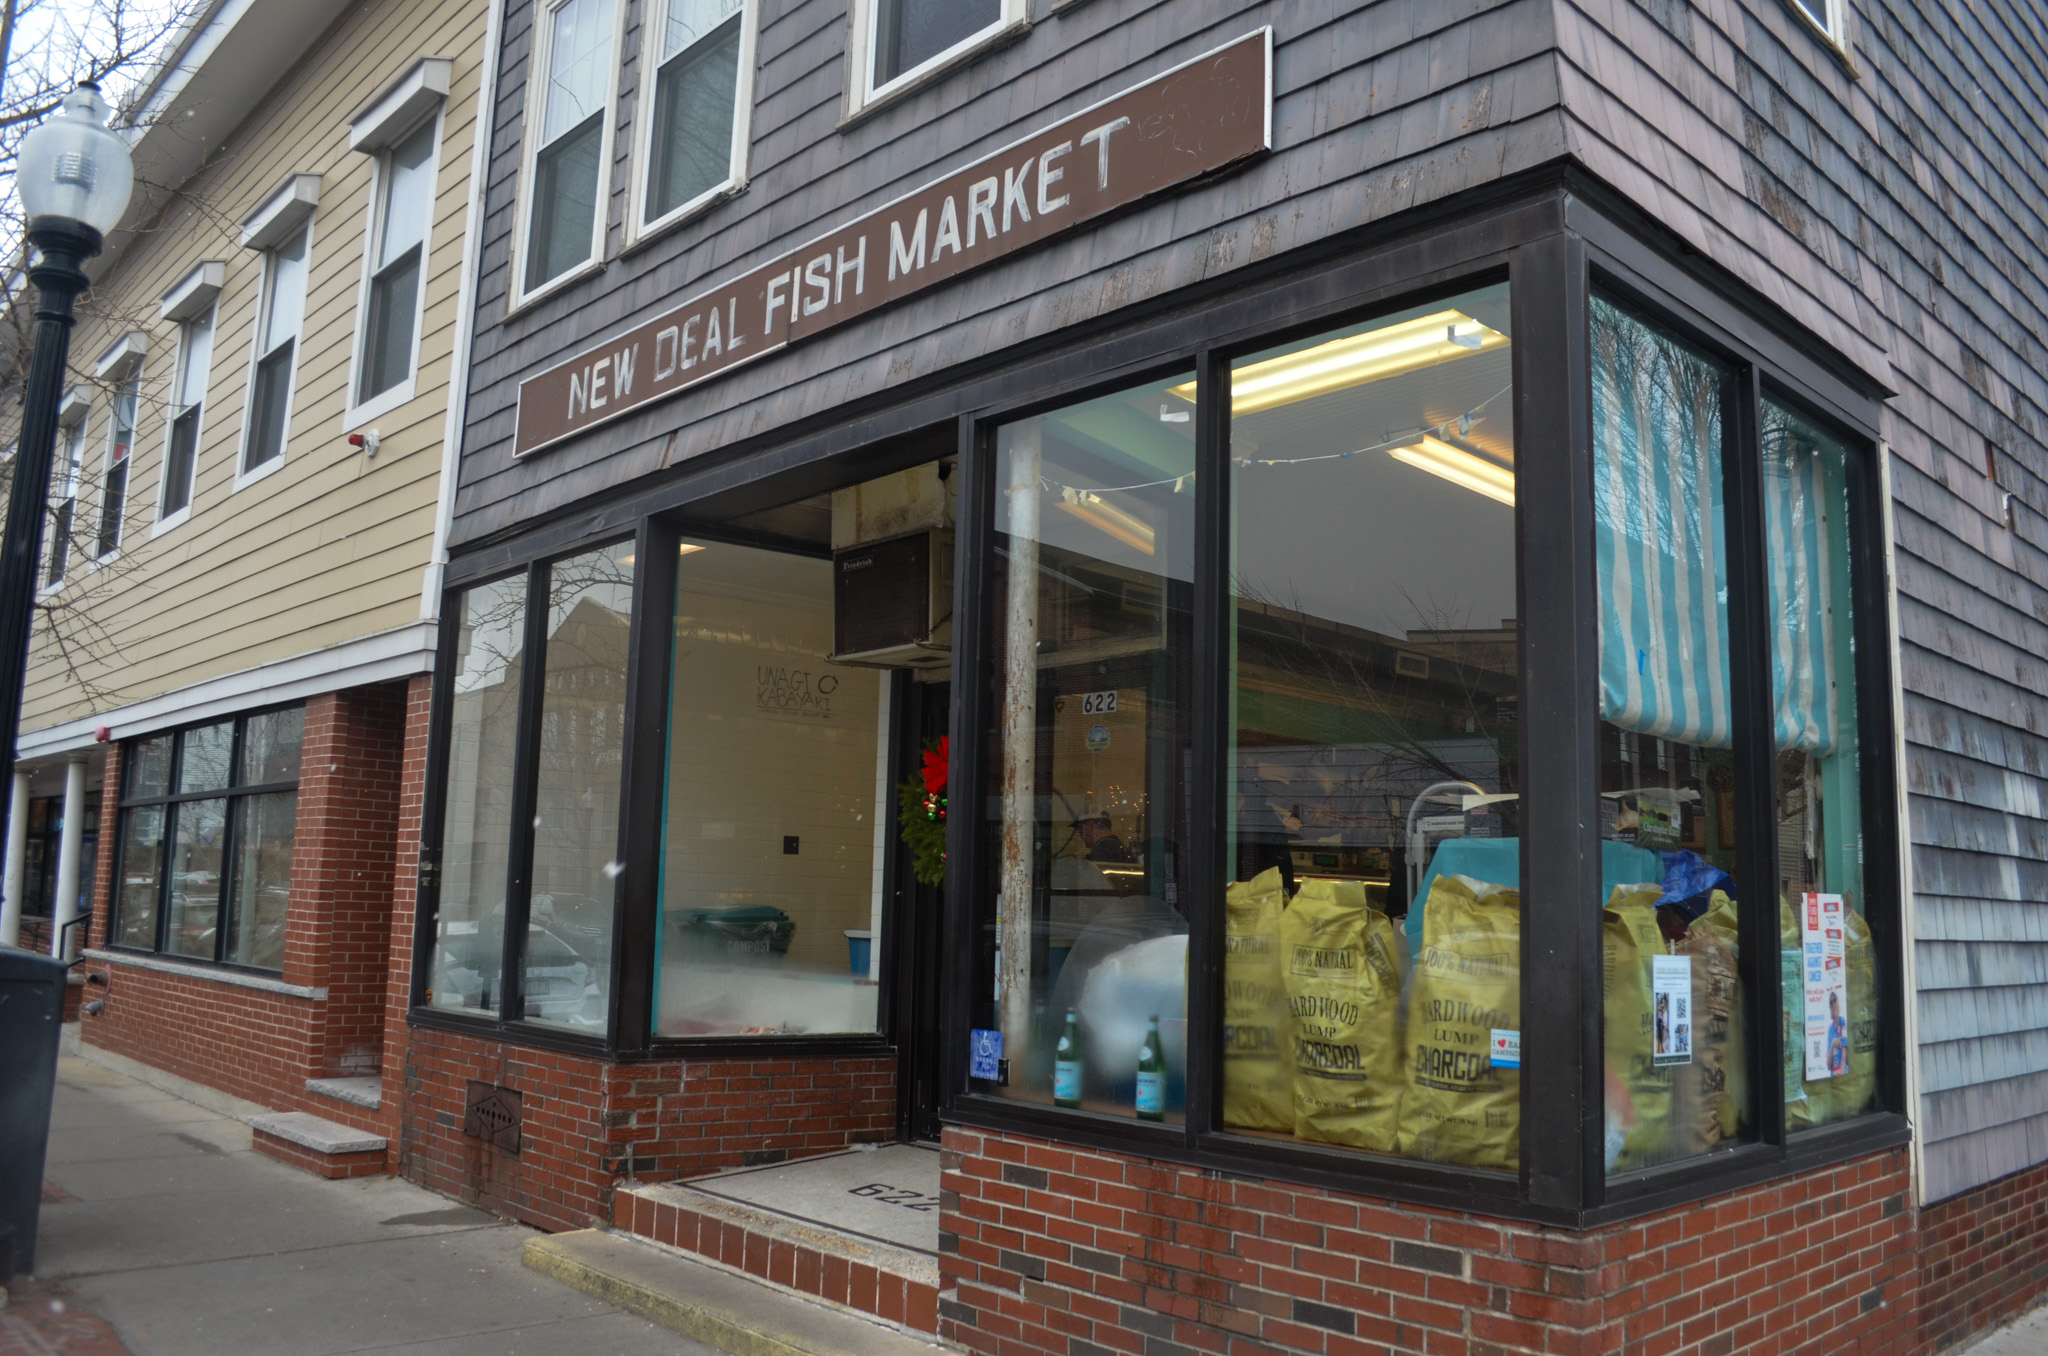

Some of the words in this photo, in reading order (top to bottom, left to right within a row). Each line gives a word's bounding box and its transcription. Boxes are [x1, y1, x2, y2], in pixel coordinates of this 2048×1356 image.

[567, 342, 639, 420] NEW
[653, 297, 745, 383] DEAL
[764, 235, 866, 335] FISH
[887, 115, 1132, 283] MARKET
[843, 558, 873, 570] Friedrich
[757, 665, 811, 695] UNAGI
[757, 686, 831, 710] KABAYAKI
[1084, 692, 1115, 713] 622
[727, 939, 769, 953] COMPOST
[1303, 1023, 1337, 1039] LUMP
[1434, 1029, 1479, 1046] LUMP
[1508, 1041, 1520, 1049] EA
